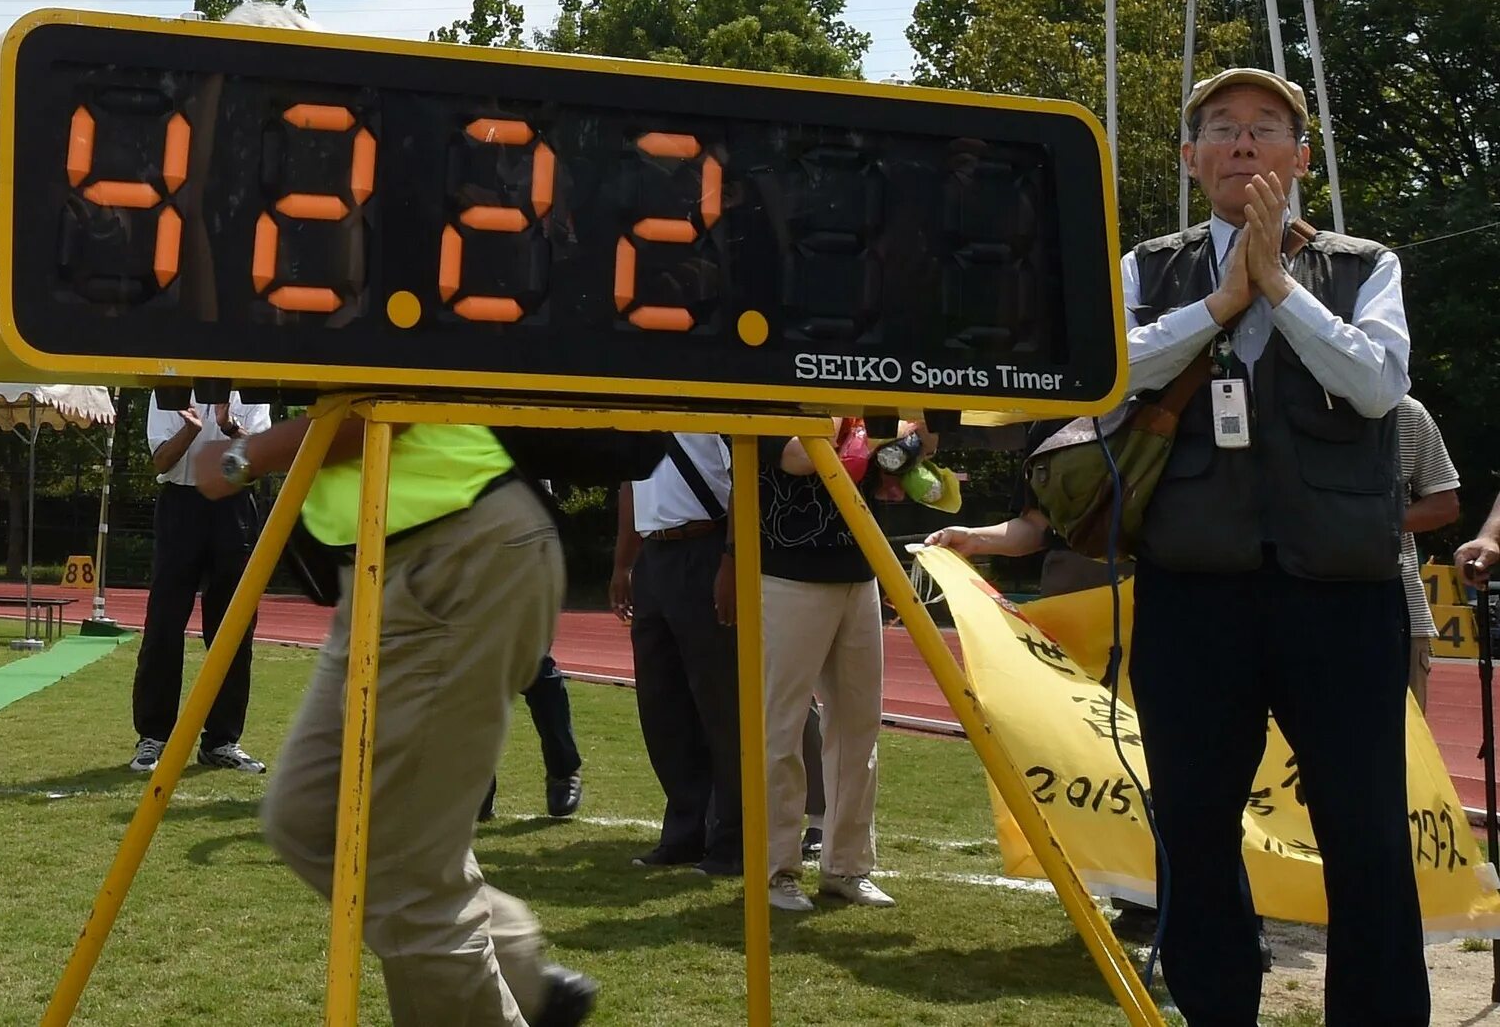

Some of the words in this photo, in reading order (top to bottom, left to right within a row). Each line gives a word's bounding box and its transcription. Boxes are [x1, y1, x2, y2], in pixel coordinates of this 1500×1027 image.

[794, 353, 901, 383] SEIKO
[911, 361, 989, 388] Sports
[996, 365, 1063, 390] Timer
[1438, 616, 1465, 648] 4
